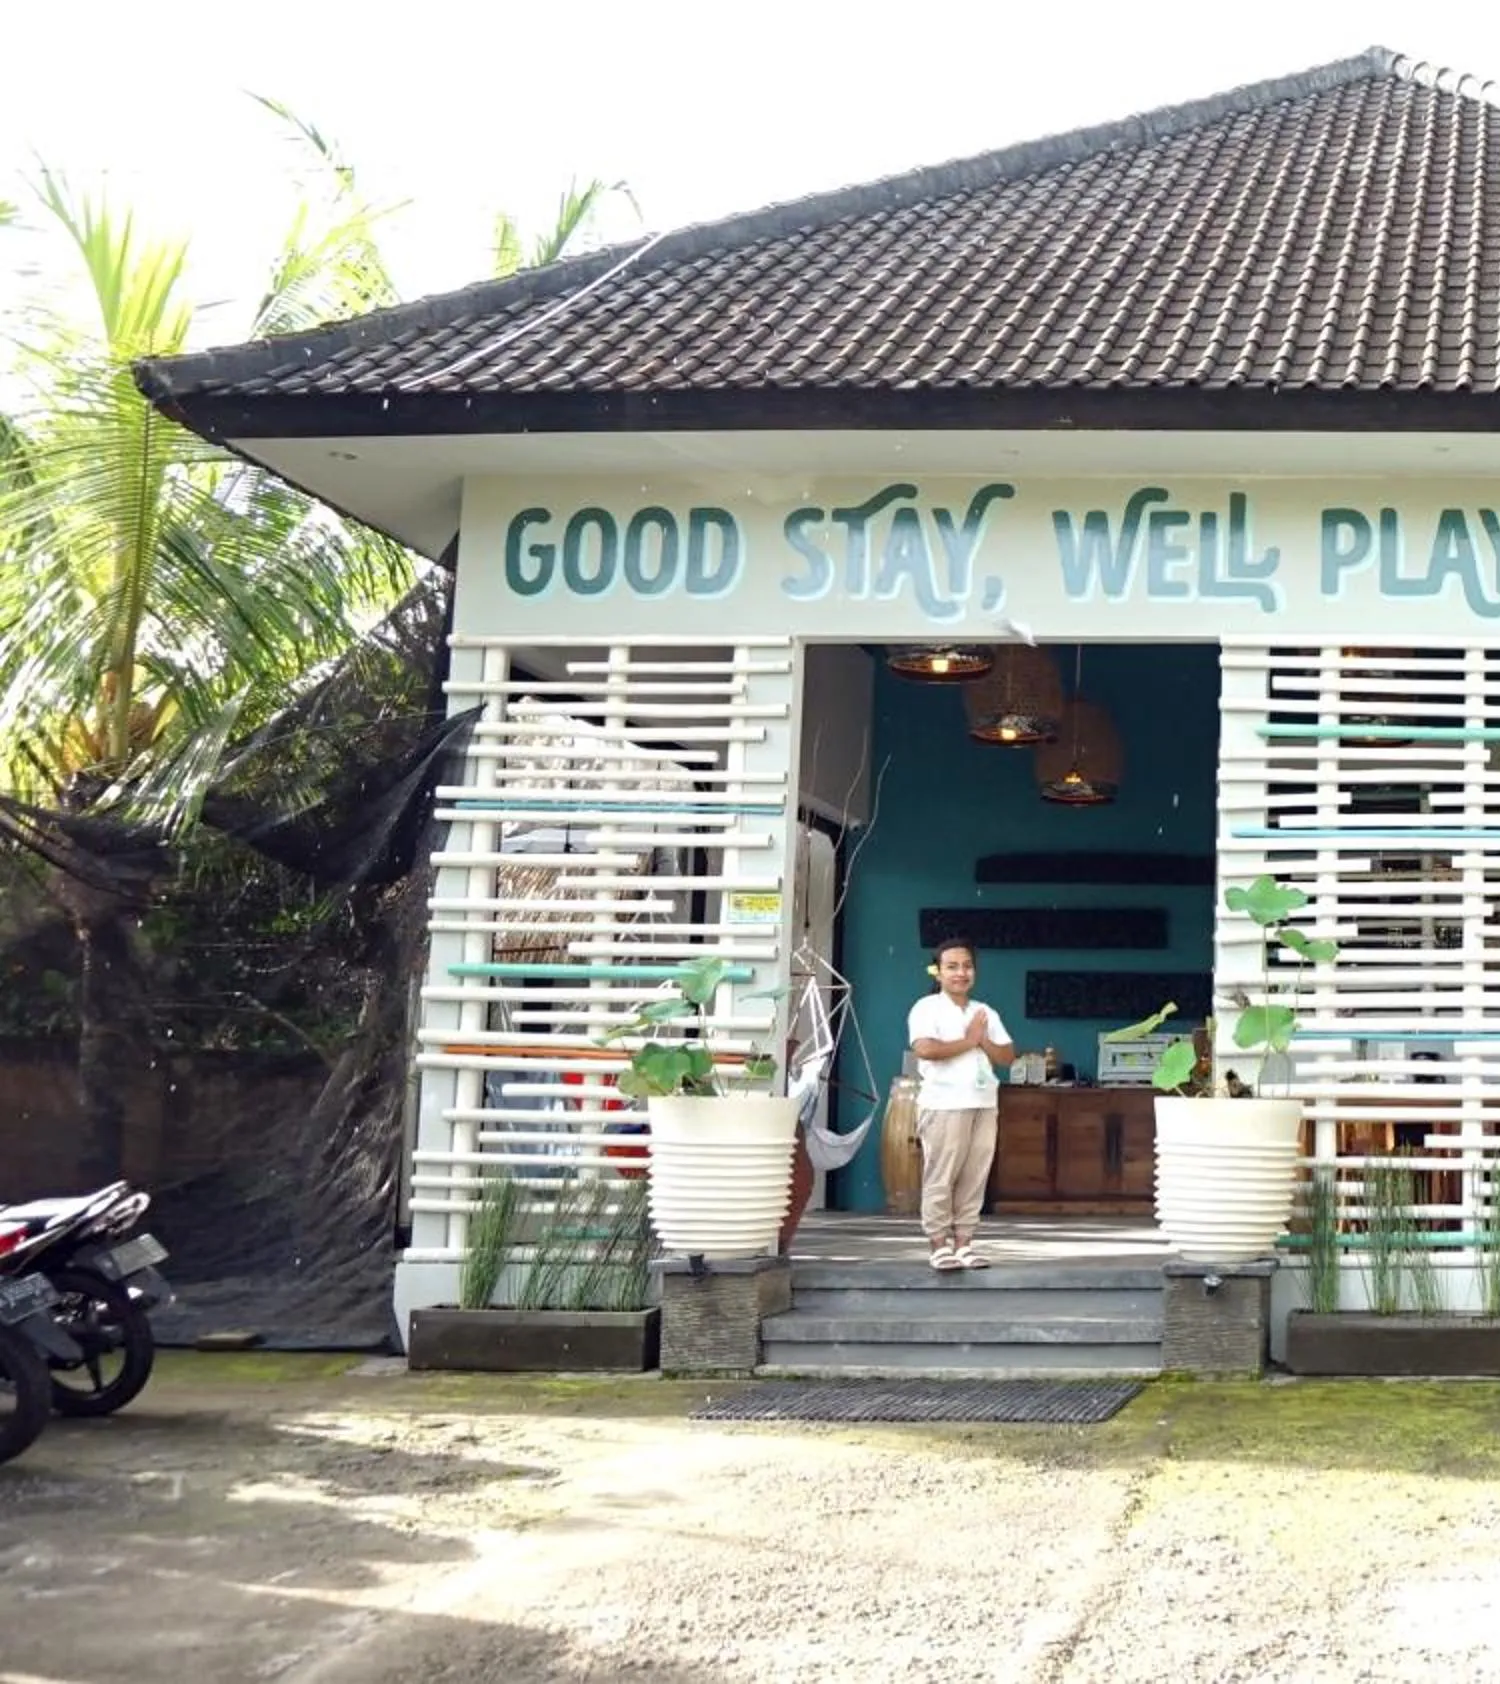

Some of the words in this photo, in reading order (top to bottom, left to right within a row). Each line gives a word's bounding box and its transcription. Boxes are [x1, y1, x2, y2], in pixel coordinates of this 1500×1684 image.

[505, 506, 745, 599] GOOD
[780, 484, 1015, 619] STAY,
[1051, 487, 1283, 614] WELL
